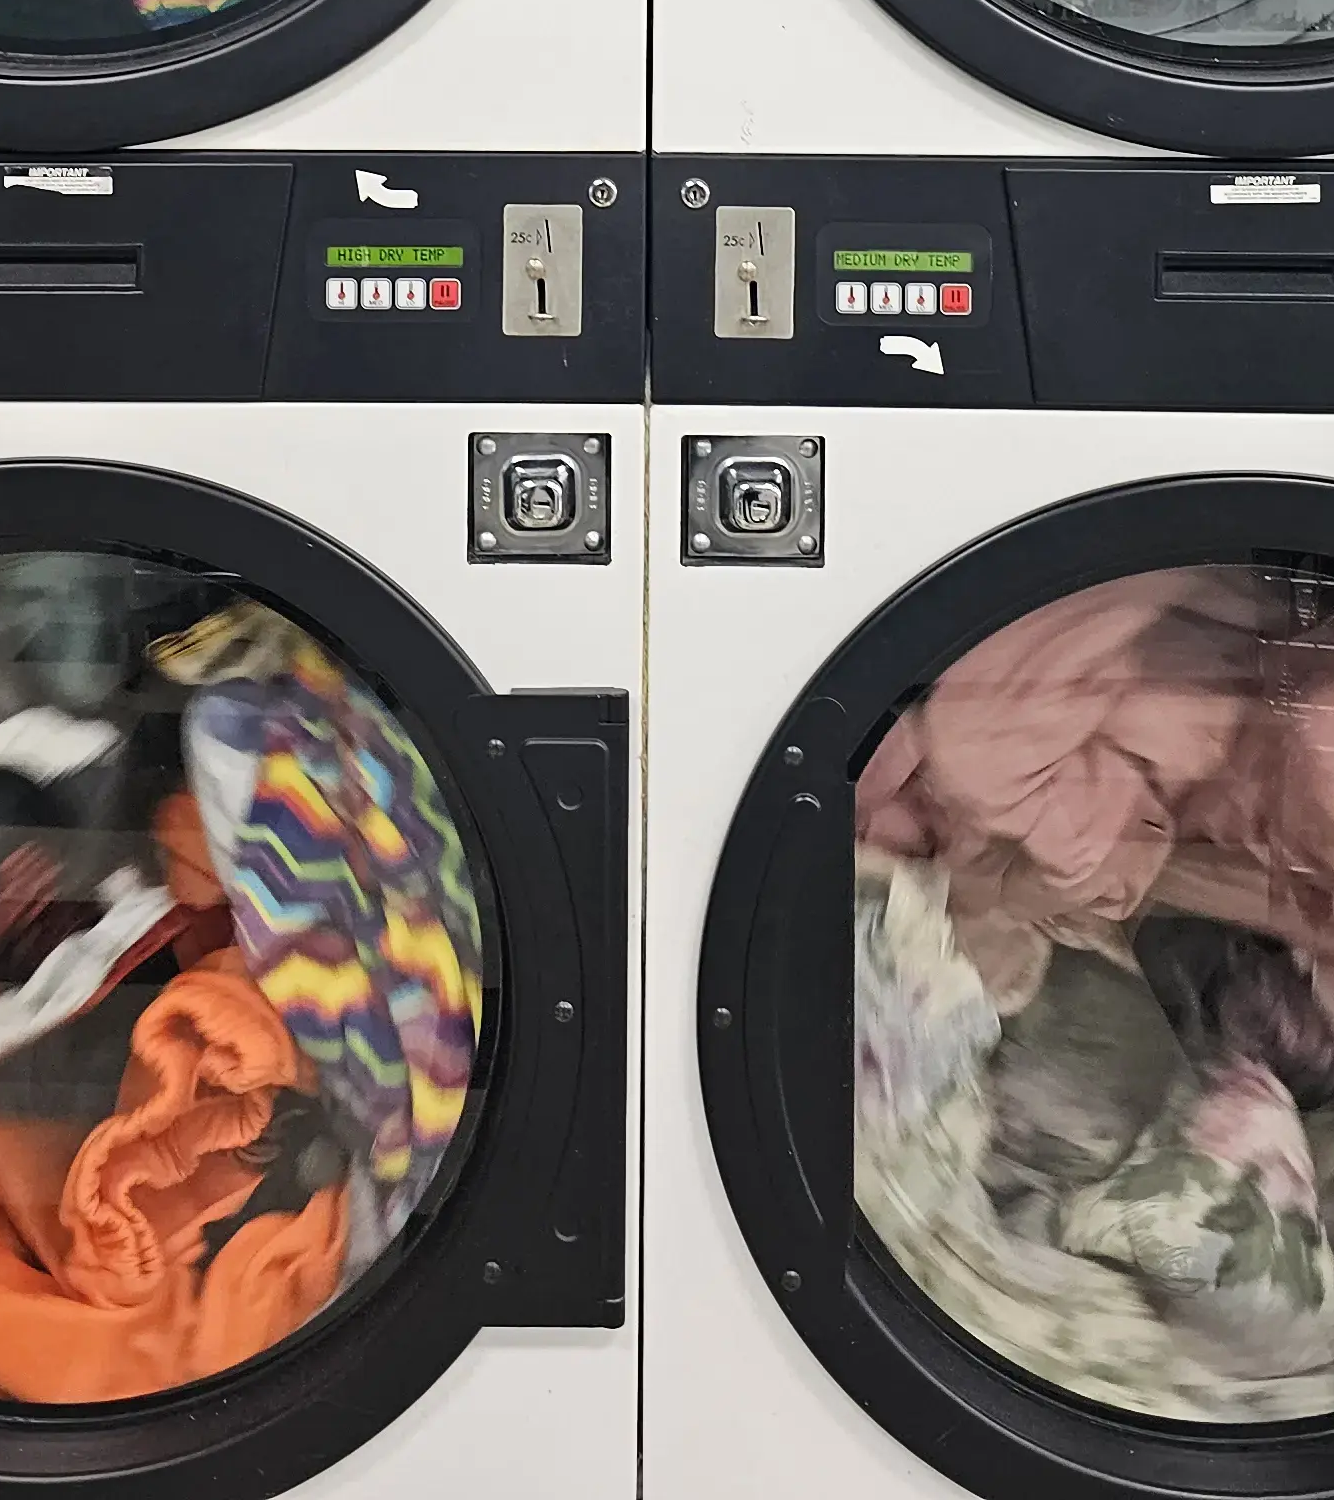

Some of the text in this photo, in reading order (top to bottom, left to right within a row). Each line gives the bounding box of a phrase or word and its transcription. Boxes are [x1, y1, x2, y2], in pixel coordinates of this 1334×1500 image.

[337, 248, 445, 262] HIGH DRY TEMP
[836, 252, 961, 268] MEDIUM DRY TEMP
